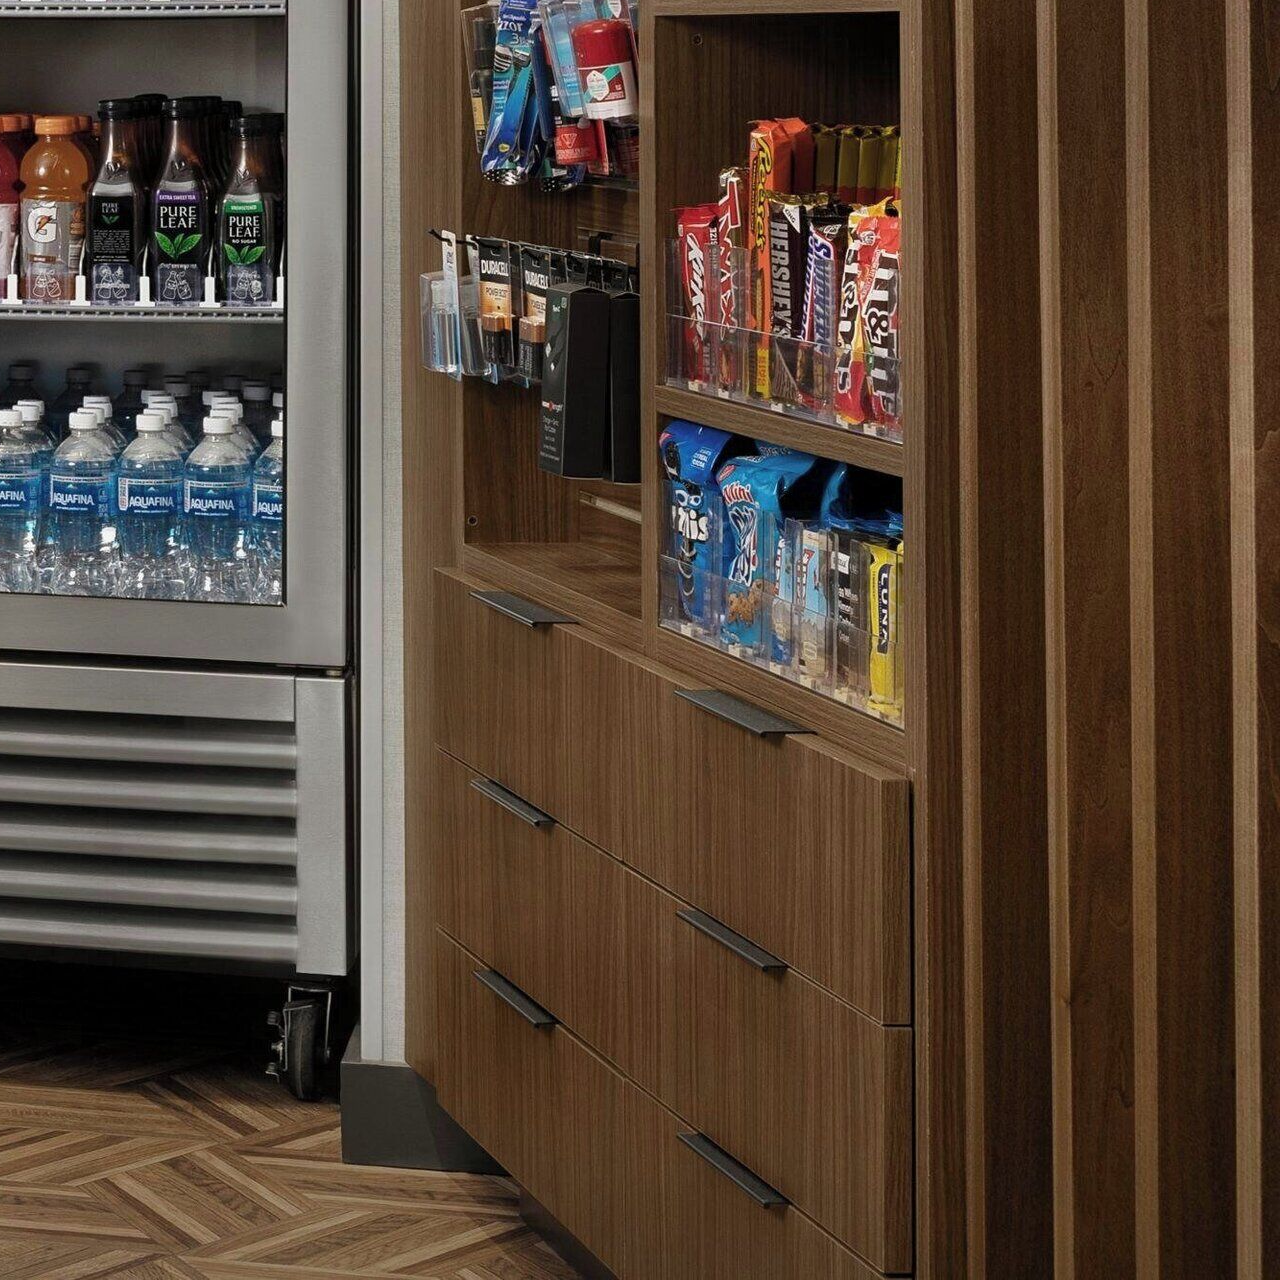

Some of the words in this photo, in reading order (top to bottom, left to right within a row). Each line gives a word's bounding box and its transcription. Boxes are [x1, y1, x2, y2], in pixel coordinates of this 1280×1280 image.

[160, 206, 197, 217] PURE
[160, 217, 196, 228] LEAF
[229, 216, 260, 227] PURE
[229, 227, 260, 238] LEAF
[481, 259, 509, 277] DURACELL
[53, 493, 95, 505] AQUAFINA
[129, 496, 175, 508] AQUAFINA
[191, 498, 234, 511] AQUAFINA
